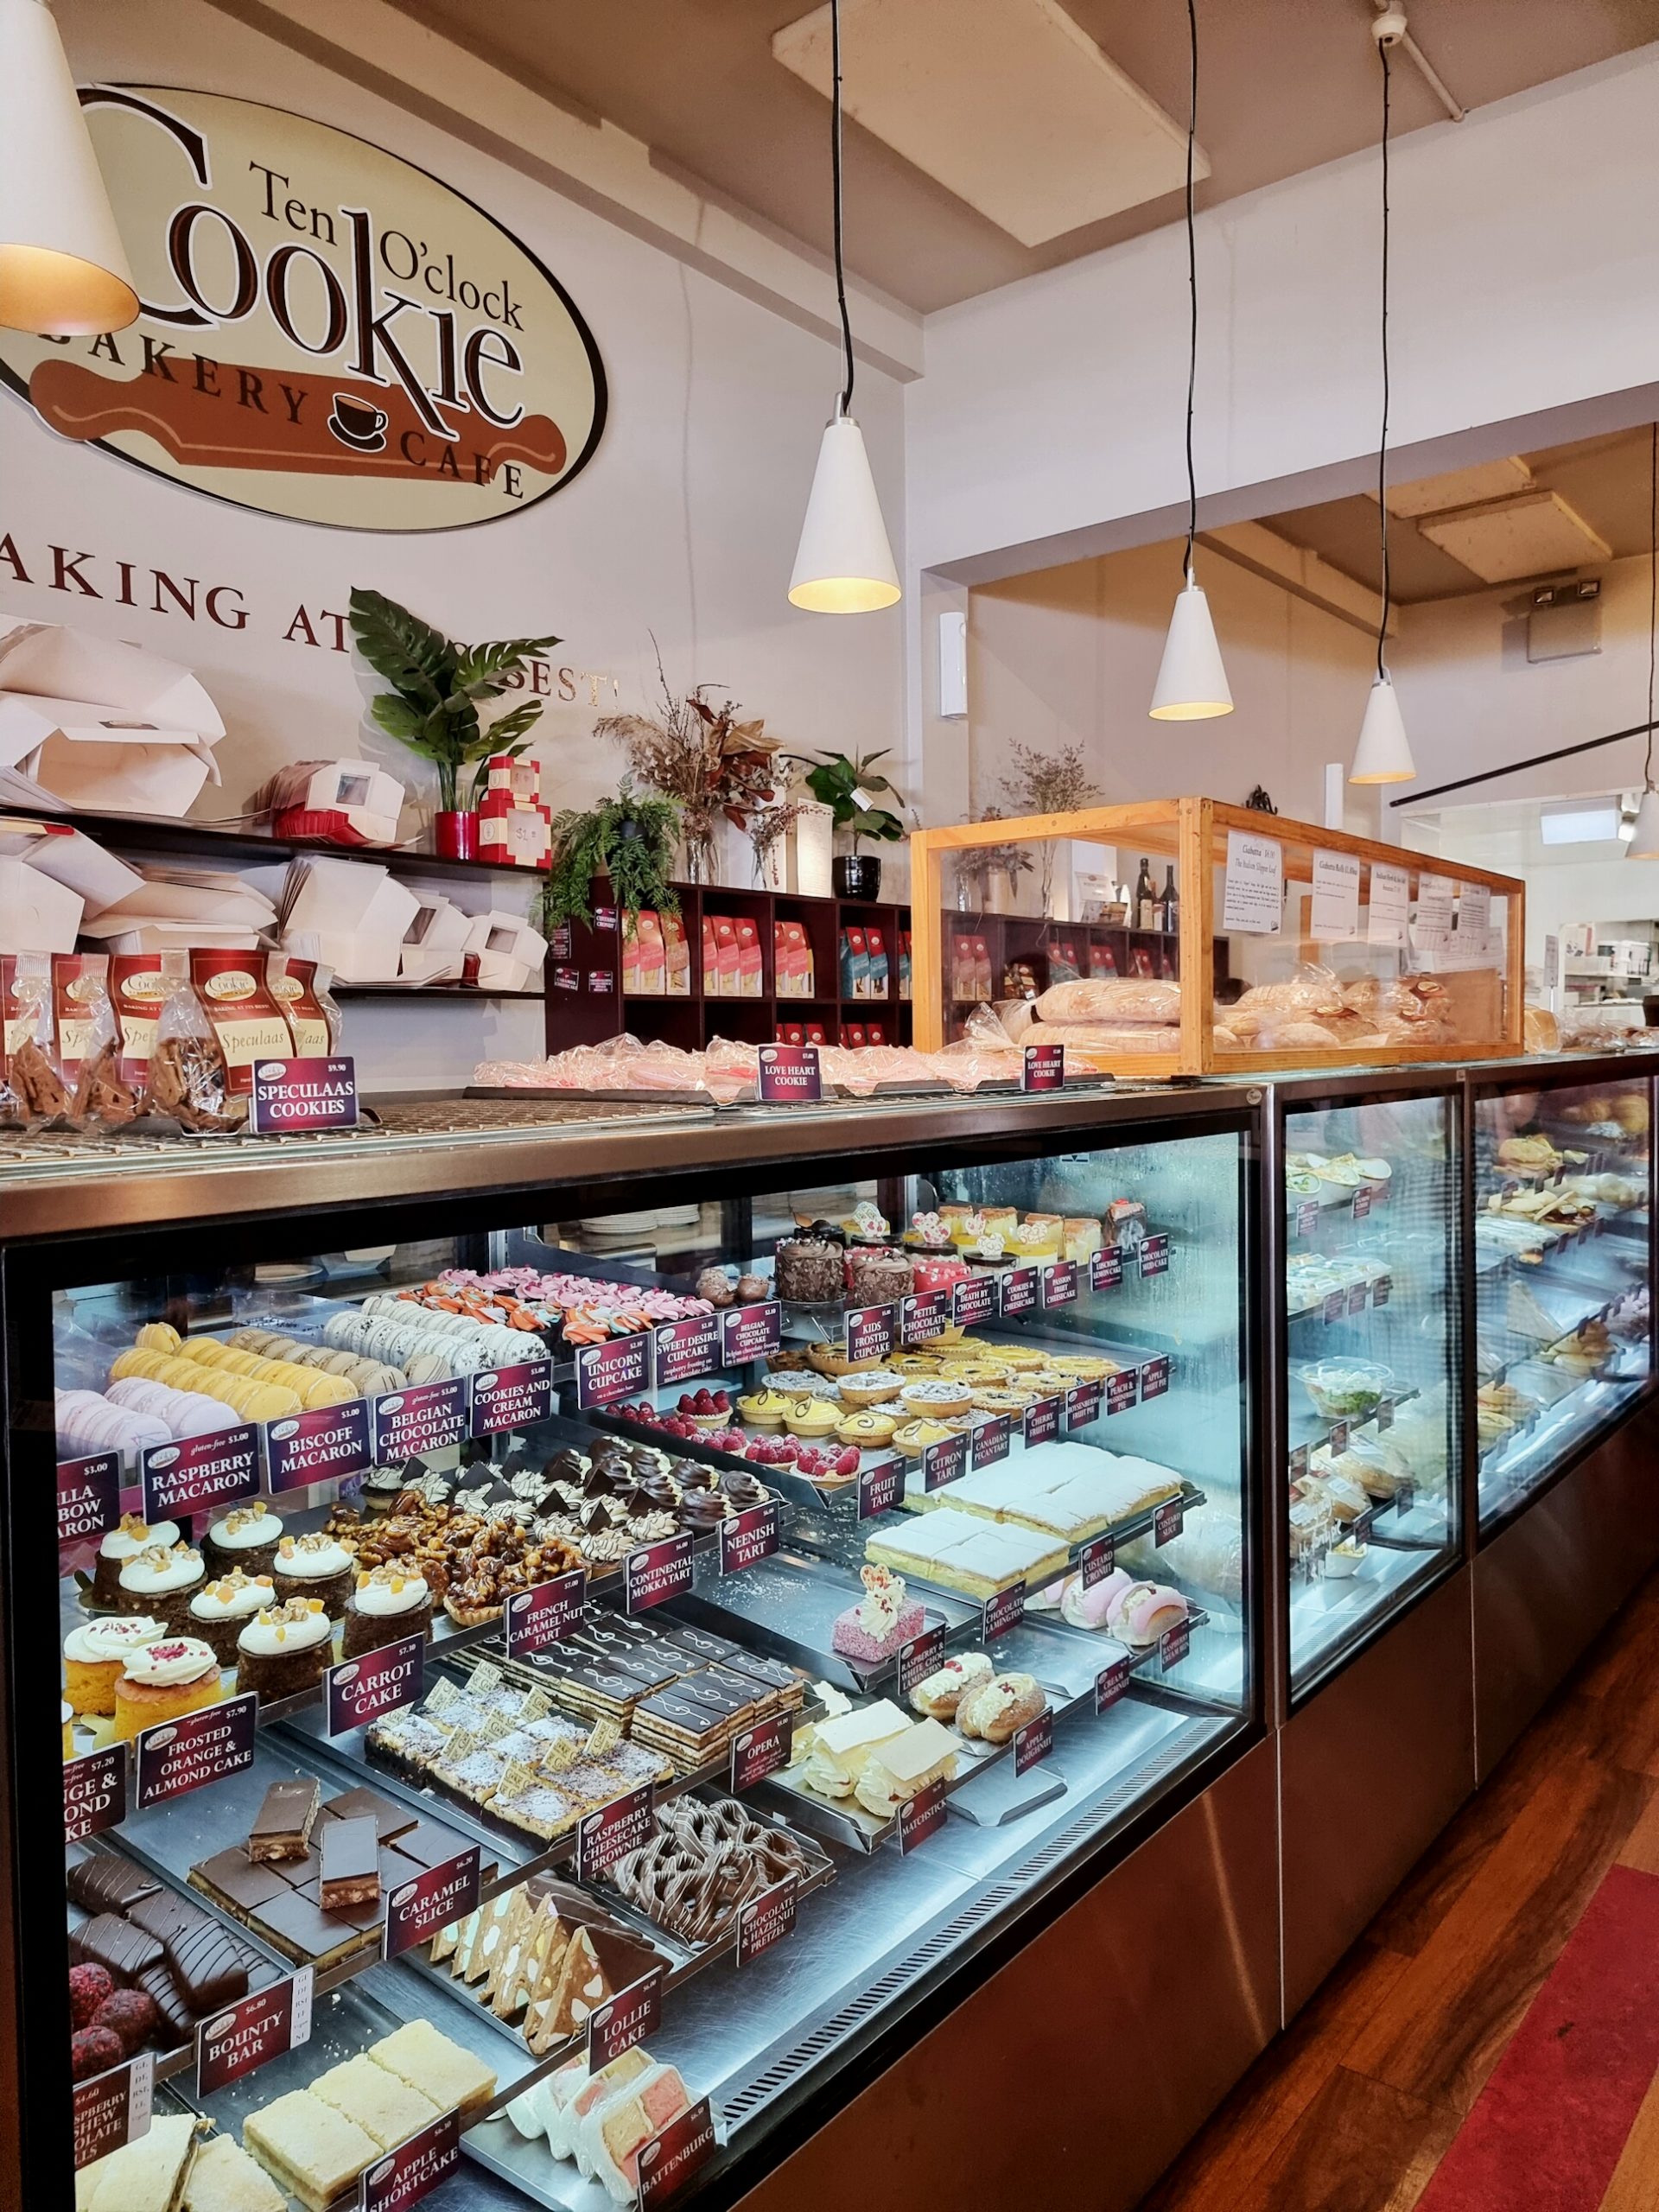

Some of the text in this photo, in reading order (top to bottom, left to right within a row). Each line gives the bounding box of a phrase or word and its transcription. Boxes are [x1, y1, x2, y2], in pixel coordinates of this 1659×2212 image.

[400, 430, 524, 499] CAFE
[283, 603, 351, 653] AT
[222, 1030, 285, 1053] Speculaas
[787, 1065, 817, 1076] HEART
[1033, 1069, 1056, 1078] COOKIE
[1043, 1059, 1061, 1069] HEART
[257, 1081, 354, 1101] SPECULAAS
[775, 1076, 808, 1087] COOKIE
[270, 1099, 346, 1118] COOKIES
[1052, 1275, 1071, 1286] PASSION
[1054, 1283, 1068, 1293] FRUIT
[957, 1297, 992, 1313] CHOCOLATE
[1003, 1297, 1035, 1312] CHEESECAKE
[1010, 1291, 1029, 1301] CREAM
[1046, 1290, 1076, 1304] CHEESECAKE
[912, 1306, 938, 1319] PETITE
[741, 1320, 766, 1332] BELGIAN
[862, 1321, 881, 1335] KIDS
[903, 1314, 946, 1332] CHOCOLATE
[688, 1331, 719, 1347] DESIRE
[735, 1327, 770, 1340] CHOCOLATE
[740, 1336, 767, 1347] CUPCAKE
[855, 1332, 889, 1348] FROSTED
[908, 1326, 941, 1343] GATEAUX
[667, 1344, 709, 1363] CUPCAKE
[854, 1342, 890, 1360] CUPCAKE
[531, 1366, 545, 1376] $3.00
[588, 1351, 643, 1376] UNICORN
[588, 1366, 643, 1391] CUPCAKE
[1148, 1370, 1163, 1382] APPLE
[442, 1386, 458, 1395] $3.00
[525, 1380, 550, 1394] AND
[341, 1408, 359, 1419] $3.00
[492, 1396, 533, 1414] CREAM
[1086, 1406, 1095, 1415] PIE
[391, 1402, 453, 1429] BELGIAN
[483, 1406, 542, 1430] MACARON
[1031, 1412, 1054, 1427] CHERRY
[378, 1414, 465, 1447] CHOCOLATE
[1046, 1421, 1056, 1431] PIE
[228, 1432, 249, 1444] $3.00
[289, 1427, 353, 1454] BISCOFF
[386, 1431, 459, 1461] MACARON
[976, 1433, 1007, 1452] CANADIAN
[994, 1441, 1008, 1454] TART
[281, 1440, 363, 1473] MACARON
[931, 1450, 963, 1471] CITRON
[84, 1462, 108, 1476] $3.00
[151, 1451, 255, 1491] RASPBERRY
[936, 1465, 957, 1482] TART
[157, 1469, 252, 1508] MACARON
[869, 1476, 897, 1496] FRUIT
[871, 1490, 894, 1509] TART
[1158, 1512, 1181, 1530] CUSTARD
[727, 1522, 775, 1553] NEENISH
[737, 1541, 766, 1563] TART
[1084, 1550, 1113, 1573] CUSTARD
[629, 1556, 693, 1588] CONTINENTAL
[668, 1568, 692, 1587] TART
[1086, 1562, 1112, 1585] CRONUT
[564, 1580, 578, 1591] $7.00
[527, 1600, 569, 1624] FRENCH
[563, 1606, 584, 1623] NUT
[986, 1596, 1024, 1624] CHOCOLATE
[985, 1607, 1024, 1635] LAMINGTON
[533, 1628, 562, 1646] TART
[938, 1642, 944, 1650] &
[925, 1650, 944, 1667] CHOC
[341, 1660, 415, 1701] CARROT
[903, 1662, 942, 1690] LAMINGTON
[1103, 1671, 1123, 1690] CREAM
[354, 1683, 403, 1714] CAKE
[226, 1705, 247, 1719] $7.90
[168, 1726, 232, 1758] FROSTED
[225, 1740, 237, 1753] &
[747, 1735, 779, 1759] OPERA
[1026, 1732, 1044, 1751] APPLE
[1017, 1735, 1052, 1768] DOUGHNUT
[91, 1757, 115, 1771] $7.20
[213, 1750, 252, 1773] CAKE
[101, 1772, 118, 1789] &
[586, 1805, 649, 1849] RASPBERRY
[902, 1797, 947, 1838] MATCHSTICK
[582, 1816, 652, 1863] CHEESECAKE
[592, 1833, 643, 1872] BROWNIE
[399, 1874, 471, 1922] CARAMEL
[415, 1897, 454, 1929] SLICE
[744, 1895, 795, 1936] CHOCOLATE
[751, 1905, 796, 1942] HAZELNUT
[751, 1923, 786, 1954] PRETZEL
[245, 1998, 267, 2015] $6.80
[604, 1999, 652, 2044] LOLLIE
[208, 2010, 284, 2063] BOUNTY
[608, 2023, 646, 2058] CAKE
[226, 2038, 264, 2069] BAR
[392, 2147, 437, 2188] APPLE
[641, 2126, 714, 2195] BATTENBURG
[370, 2146, 459, 2212] SHORTCAKE
